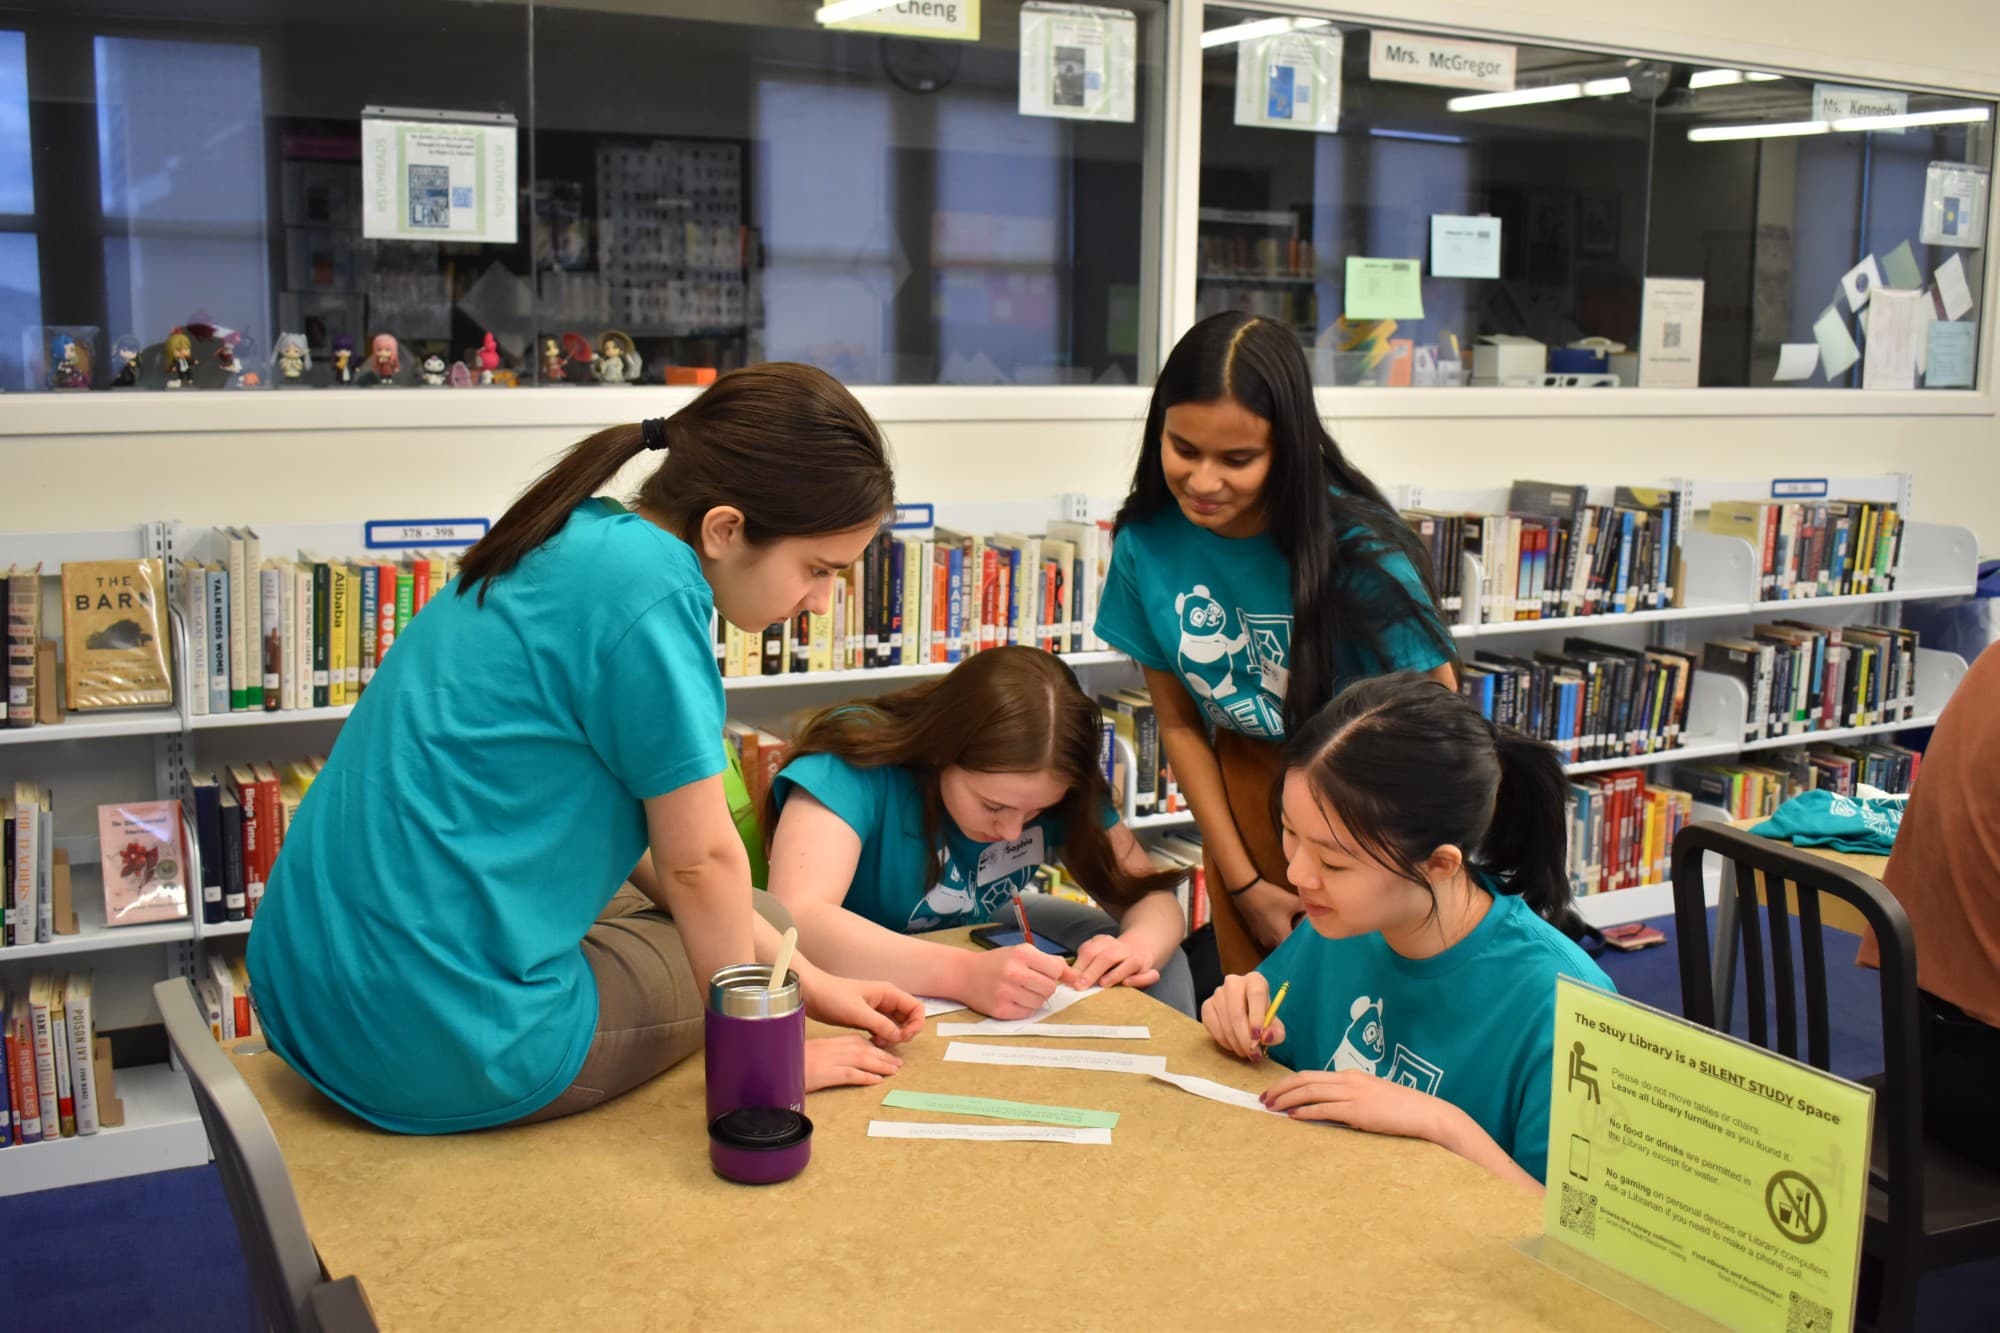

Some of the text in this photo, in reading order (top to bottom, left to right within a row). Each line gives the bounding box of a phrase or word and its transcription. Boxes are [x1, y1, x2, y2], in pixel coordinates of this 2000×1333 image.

[1385, 45, 1502, 77] Mrs. McGregor
[1823, 98, 1842, 113] Ms.
[96, 575, 132, 587] THE
[334, 572, 345, 628] Alibaba
[364, 570, 375, 599] HAPPY
[213, 578, 223, 676] YALE NEEDS WOME
[364, 611, 374, 628] ANY
[244, 788, 256, 851] Binge Times
[1006, 838, 1033, 854] Sophia
[37, 1013, 47, 1035] GAME
[72, 1009, 86, 1043] POISON
[76, 1046, 87, 1062] IVY
[1574, 1012, 1841, 1125] The Stuy Library is a SILENT STUDY Space
[1611, 1067, 1639, 1086] Please
[1641, 1079, 1652, 1091] do
[1653, 1083, 1667, 1097] not
[1668, 1092, 1692, 1106] move
[1694, 1101, 1719, 1118] tables
[1721, 1113, 1731, 1122] or
[1611, 1080, 1637, 1098] Leave
[1638, 1089, 1649, 1103] all
[1651, 1096, 1682, 1118] Library
[1684, 1110, 1723, 1134] furniture
[1725, 1128, 1736, 1139] as
[1738, 1135, 1755, 1148] you
[1756, 1139, 1781, 1158] found
[1608, 1130, 1621, 1142] the
[1622, 1135, 1650, 1157] Library
[1652, 1151, 1680, 1168] except
[1681, 1161, 1693, 1173] for
[1609, 1117, 1752, 1186] No food or drinks are permitted in
[1604, 1179, 1619, 1192] Ask
[1620, 1188, 1627, 1196] a
[1628, 1190, 1663, 1214] Librarian
[1665, 1207, 1671, 1217] if
[1672, 1213, 1687, 1225] you
[1689, 1219, 1711, 1235] need
[1712, 1230, 1721, 1241] to
[1722, 1235, 1746, 1253] make
[1748, 1248, 1754, 1257] a
[1756, 1252, 1784, 1271] phone
[1606, 1167, 1618, 1180] No
[1619, 1175, 1651, 1196] gaming
[1653, 1189, 1664, 1200] on
[1666, 1195, 1701, 1217] personal
[1704, 1212, 1735, 1233] devices
[1737, 1229, 1746, 1238] or
[1748, 1233, 1779, 1256] Library
